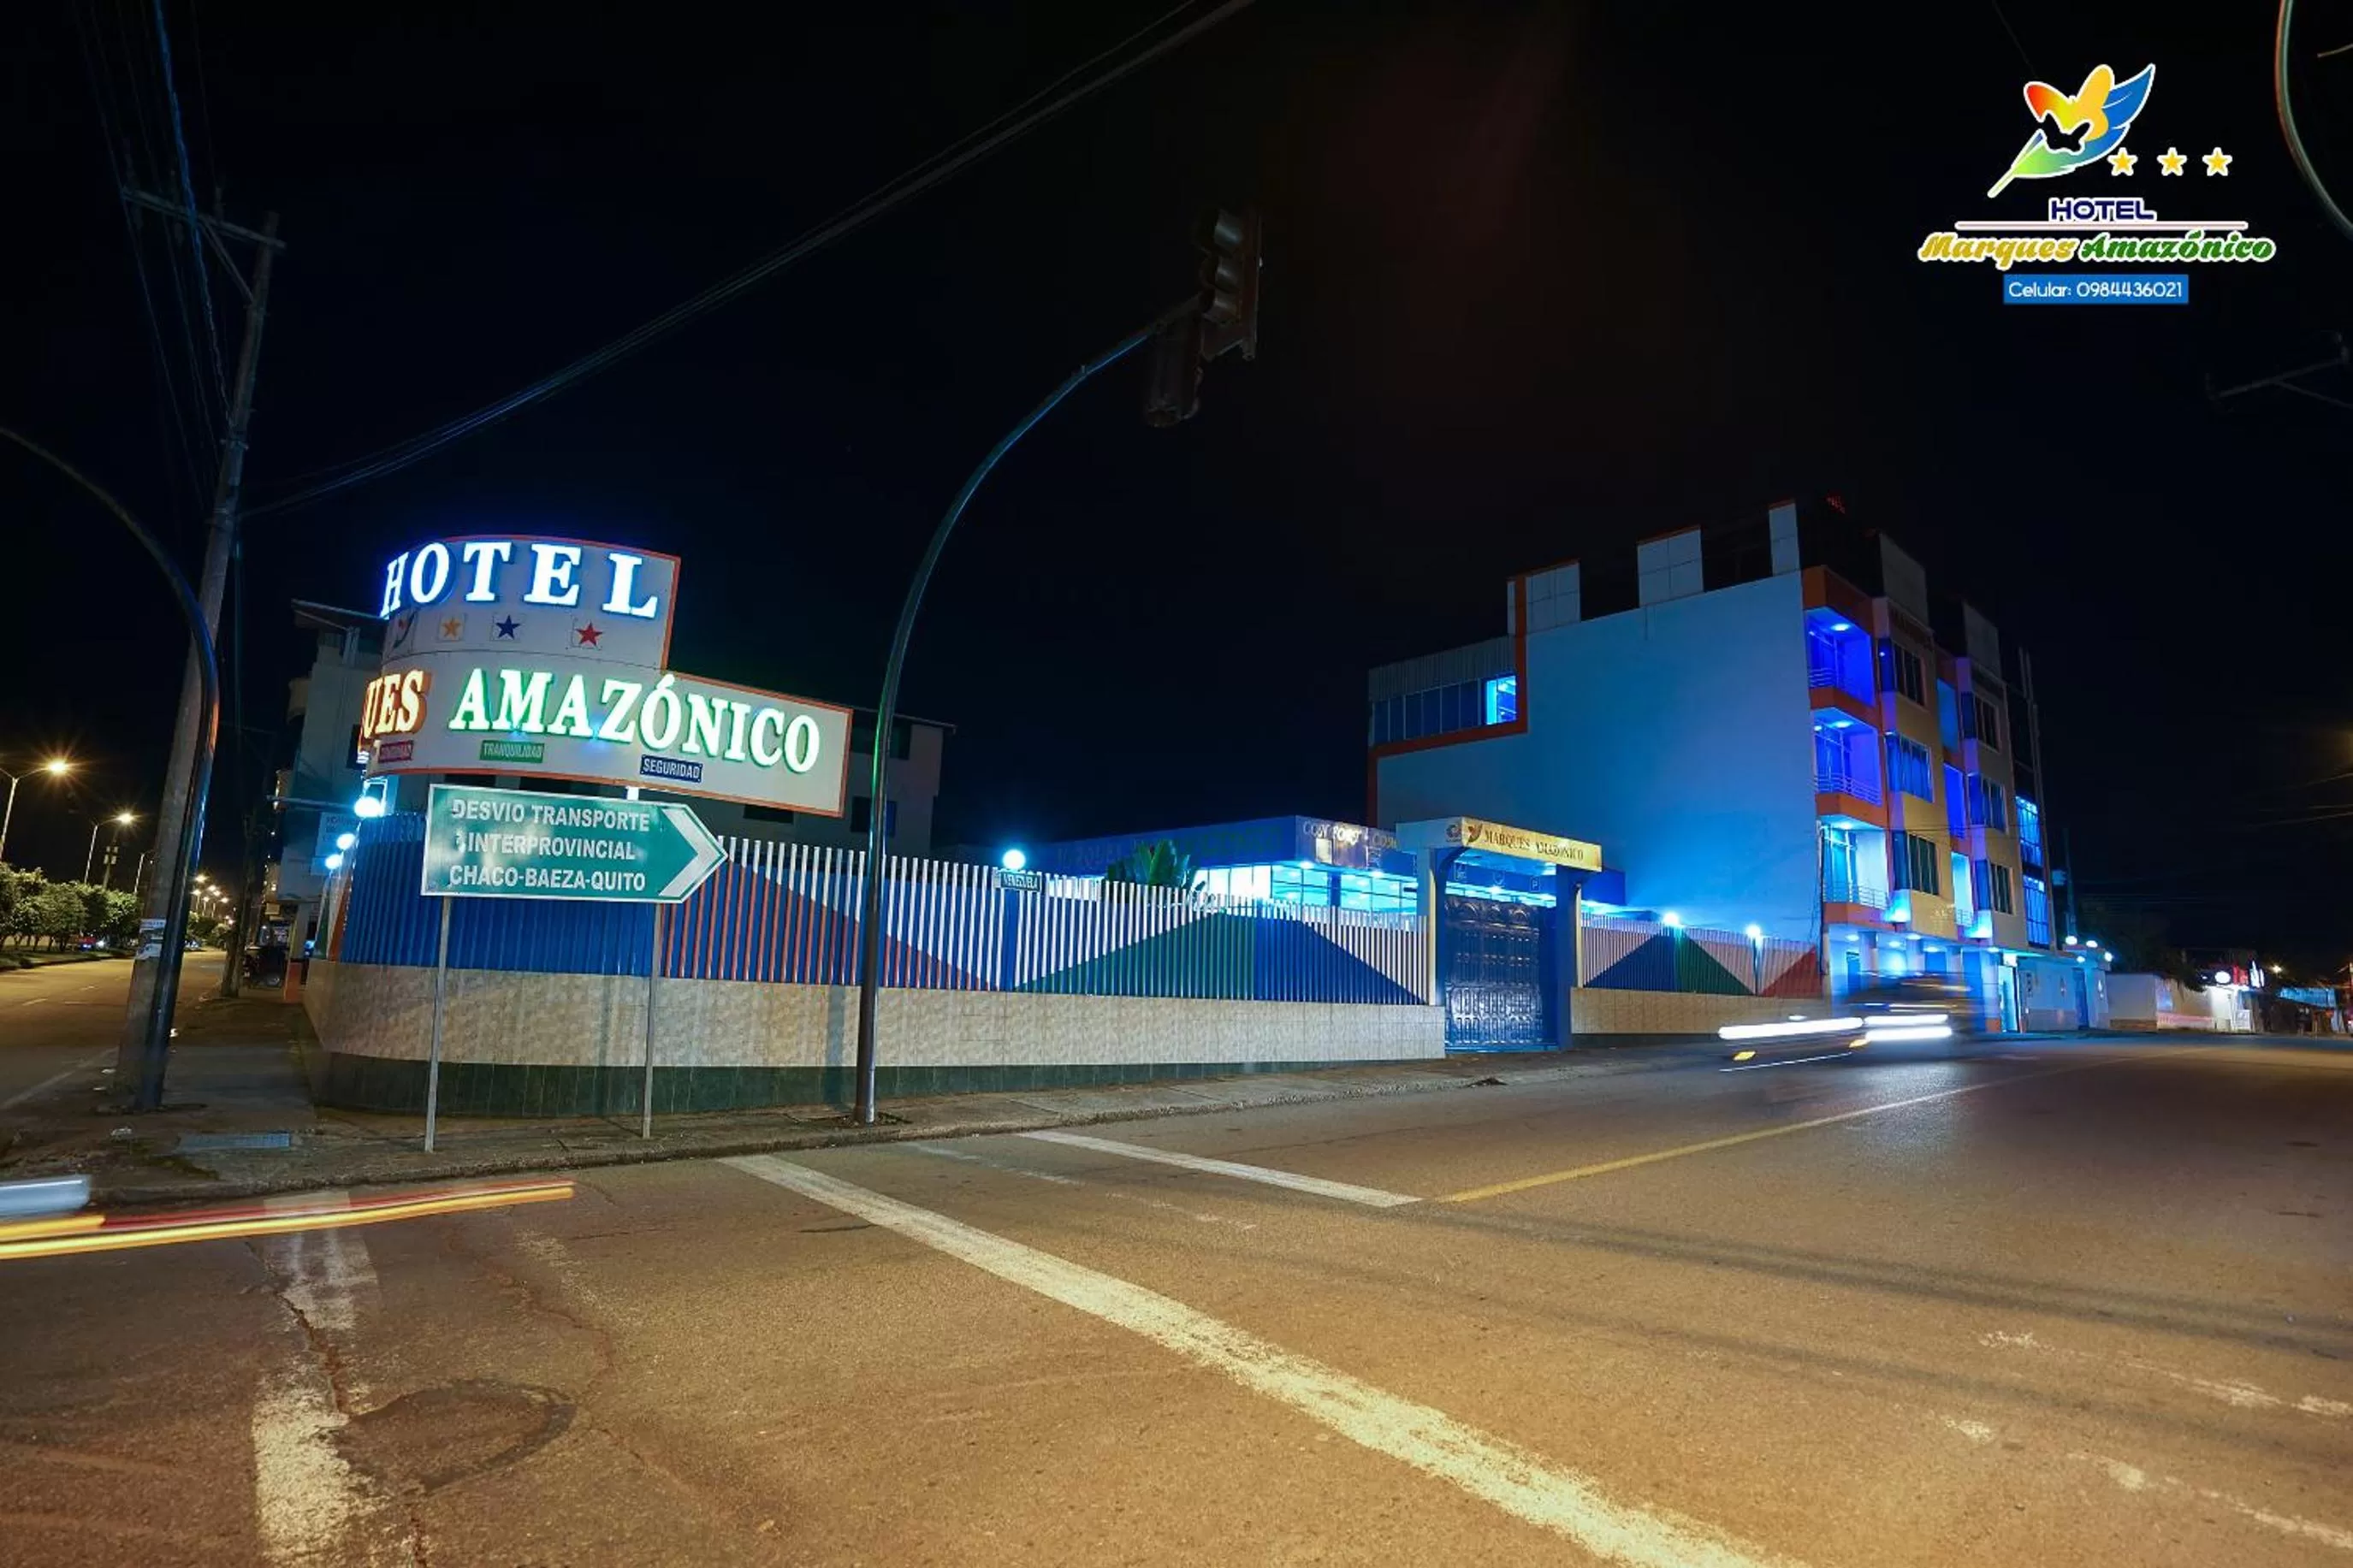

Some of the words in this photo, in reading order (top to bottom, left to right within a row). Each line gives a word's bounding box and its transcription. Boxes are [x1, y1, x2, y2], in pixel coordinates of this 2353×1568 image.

[379, 541, 659, 619] HOTEL
[447, 667, 821, 774] AMAZÓNICO
[483, 742, 542, 760] TRANQUILIDAD
[643, 757, 701, 780] SEGURIDAD
[451, 799, 525, 823] DESVIO
[531, 805, 650, 832] TRANSPORTE
[467, 832, 636, 861] INTERPROVINCIAL
[1485, 829, 1531, 850] MARQUES
[448, 865, 646, 892] CHACO-BAEZA-QUITO
